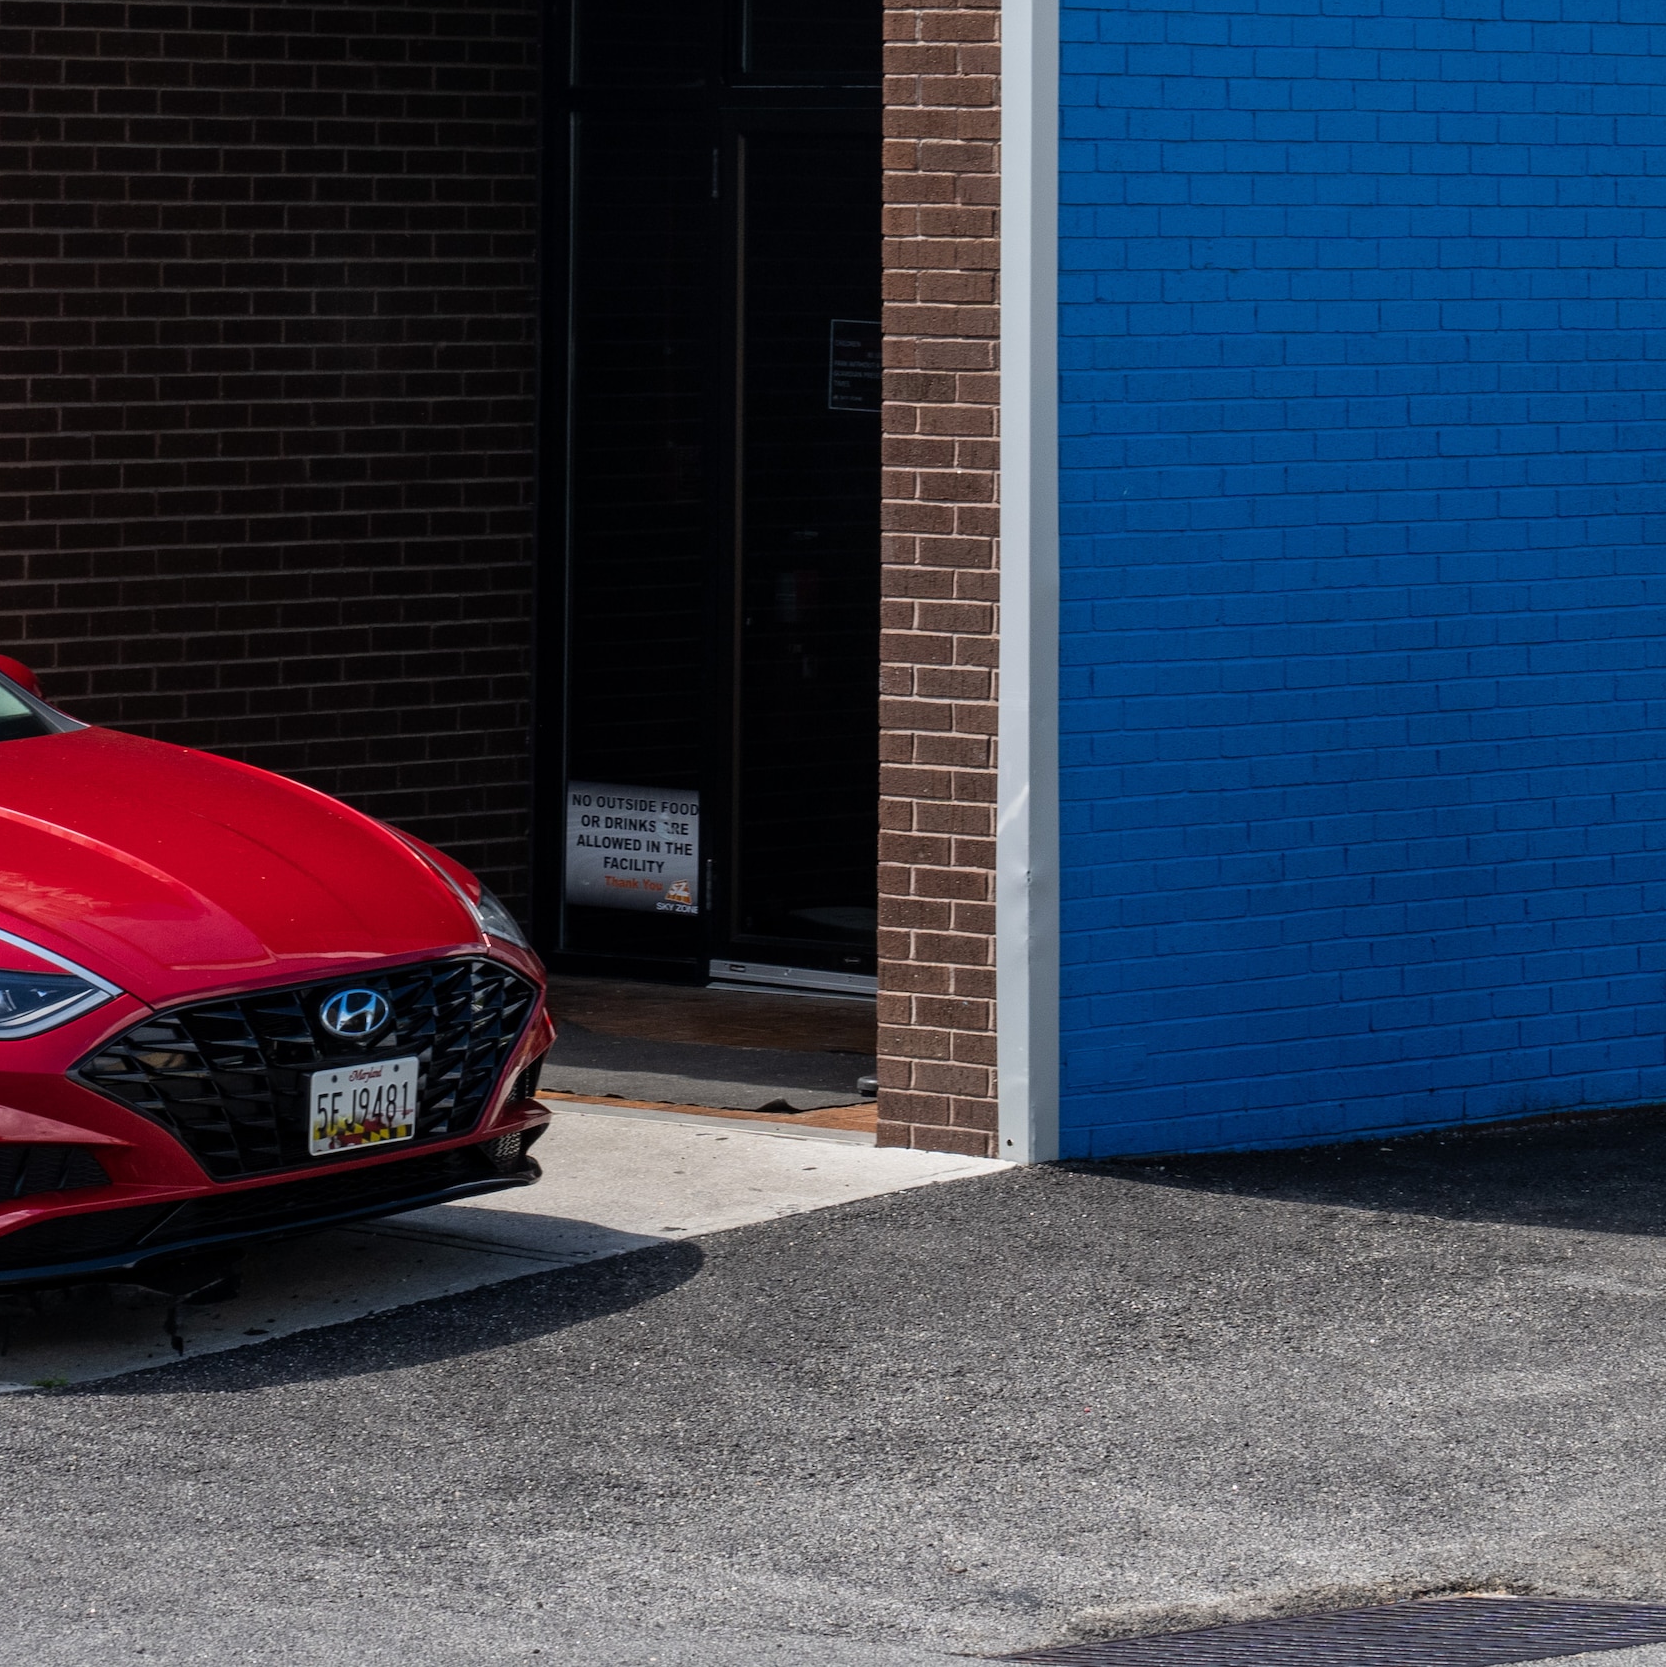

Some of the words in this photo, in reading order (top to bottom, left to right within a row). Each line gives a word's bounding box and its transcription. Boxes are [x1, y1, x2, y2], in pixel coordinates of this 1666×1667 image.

[572, 793, 593, 807] NO
[597, 795, 657, 813] OUTSIDE
[661, 801, 699, 816] FOOD
[581, 814, 600, 828] OR
[605, 816, 657, 833] DRINKS
[576, 833, 642, 852] ALLOWED
[646, 840, 661, 853] IN
[665, 841, 693, 856] THE
[603, 856, 665, 874] FACILITY
[604, 875, 639, 889] Thank
[643, 878, 664, 891] You
[656, 902, 675, 911] SKY
[675, 903, 699, 915] ZONE
[348, 1065, 384, 1083] Maryland
